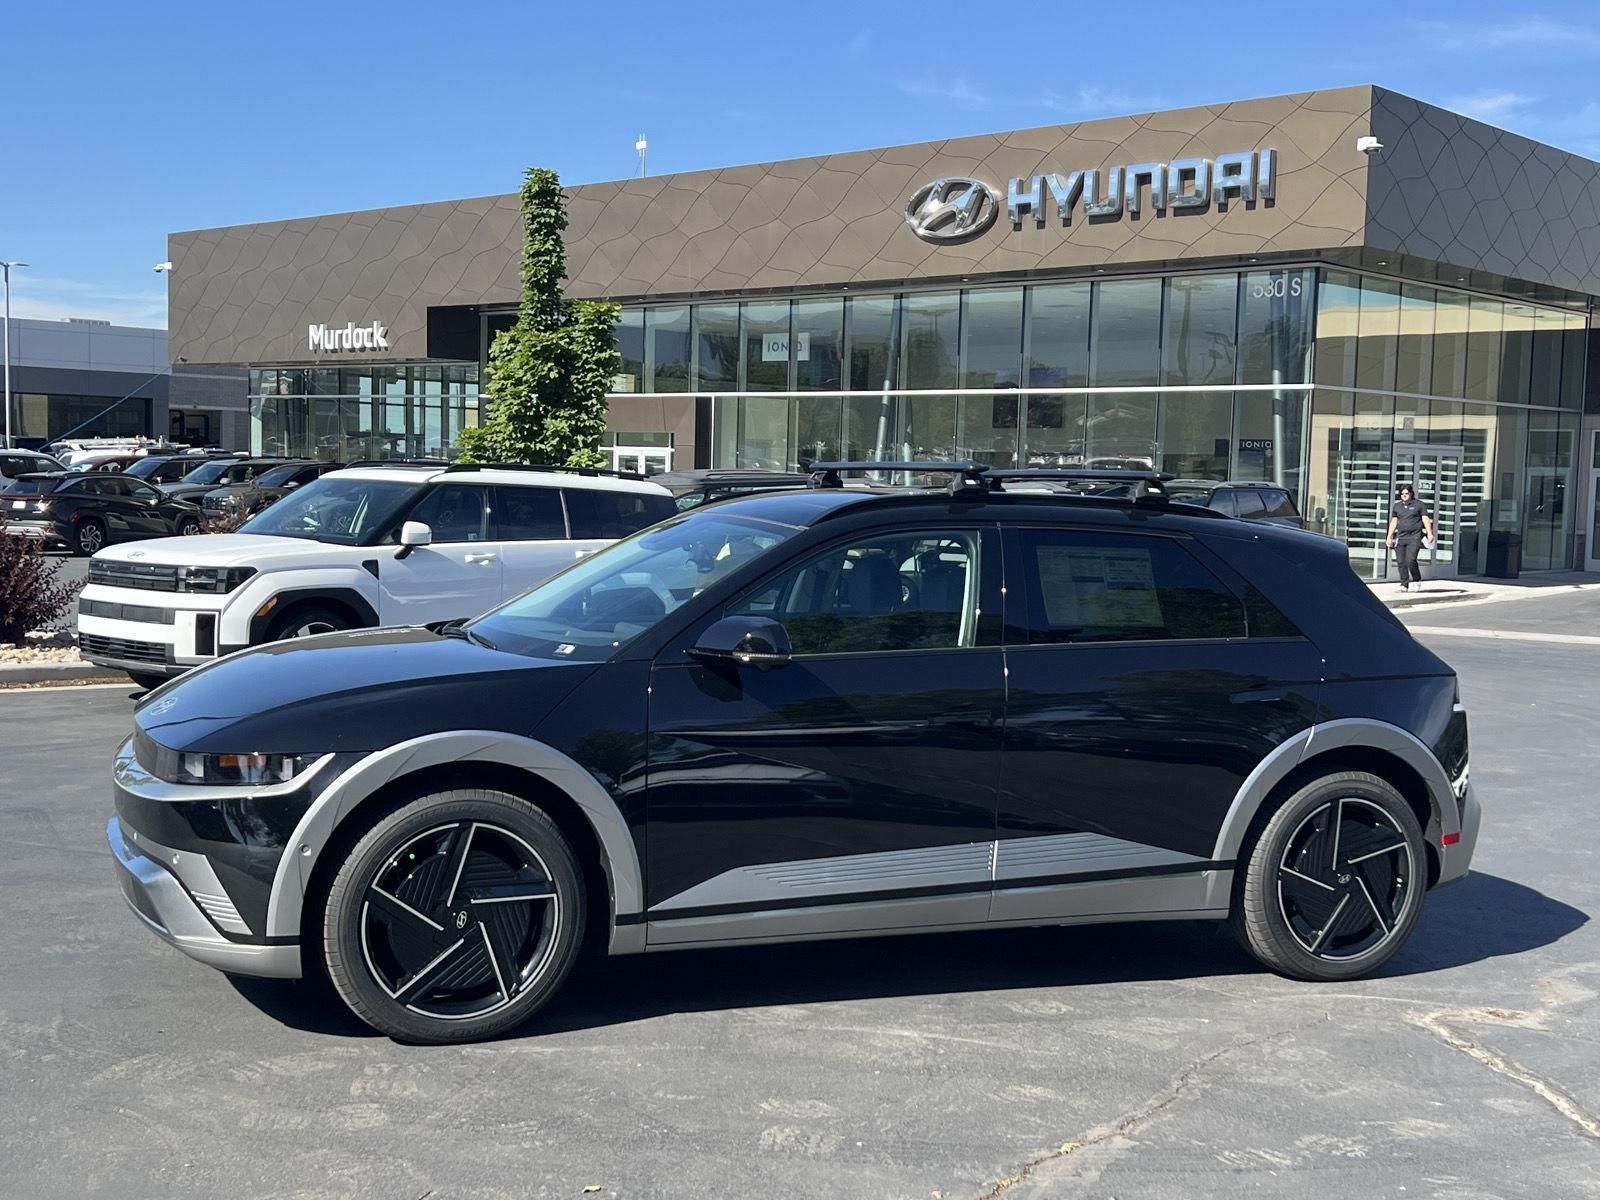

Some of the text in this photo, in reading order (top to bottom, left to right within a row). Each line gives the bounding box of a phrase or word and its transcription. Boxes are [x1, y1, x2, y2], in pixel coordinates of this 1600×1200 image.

[1007, 148, 1278, 225] HYUNDAI
[1253, 277, 1301, 298] 530 S
[308, 320, 389, 350] Murdock
[767, 341, 803, 353] IONQ
